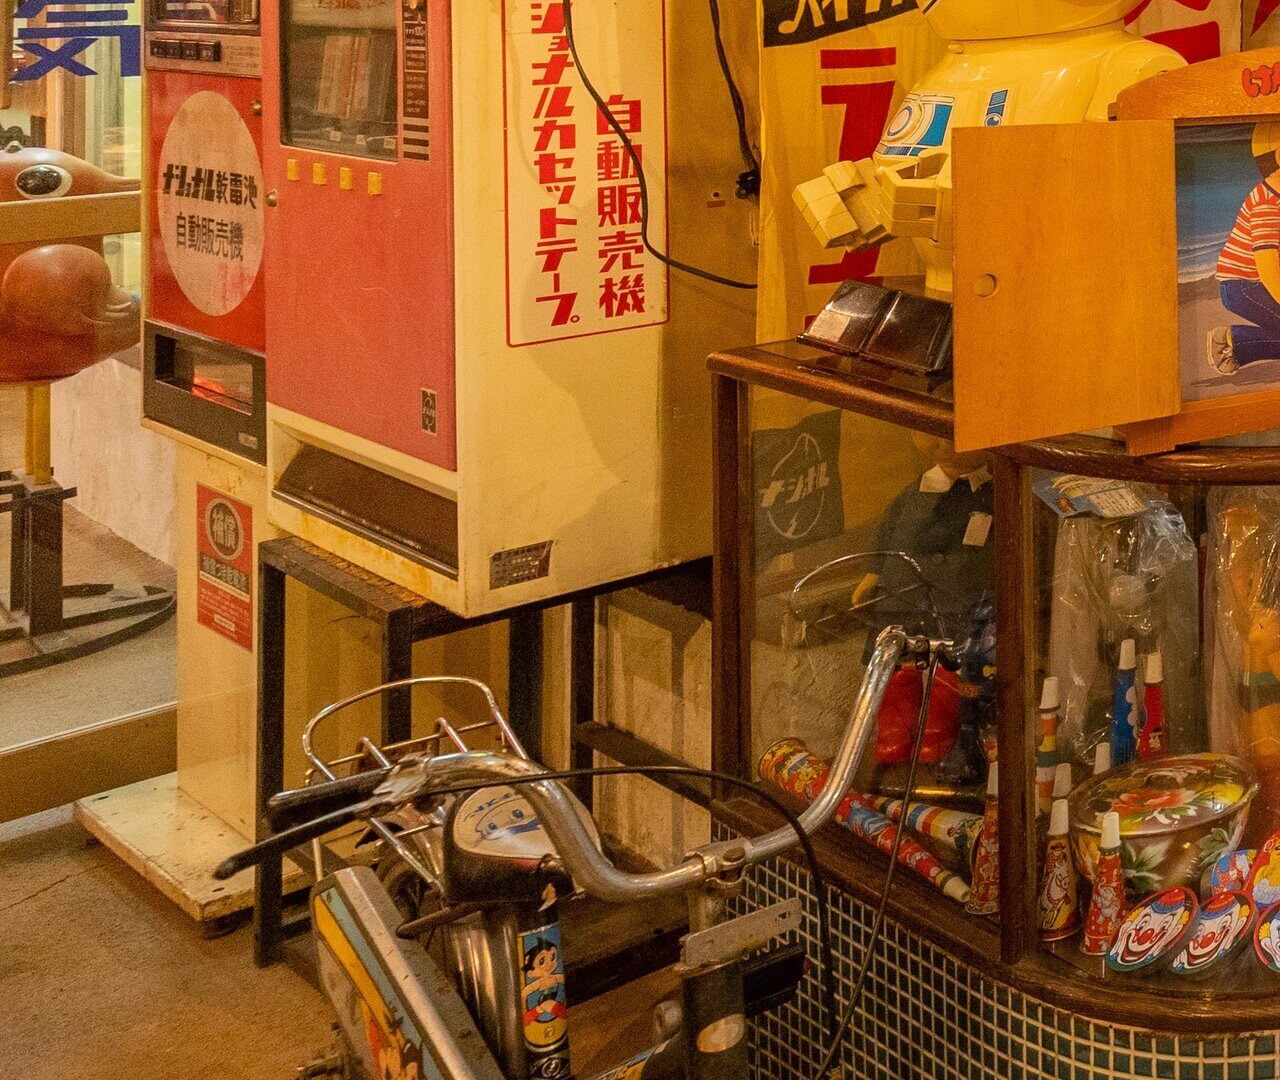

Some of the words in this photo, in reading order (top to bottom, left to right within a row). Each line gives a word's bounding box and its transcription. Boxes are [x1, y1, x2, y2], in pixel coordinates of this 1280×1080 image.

[176, 211, 245, 262] 自動販売機
[596, 95, 646, 318] 自動販売機
